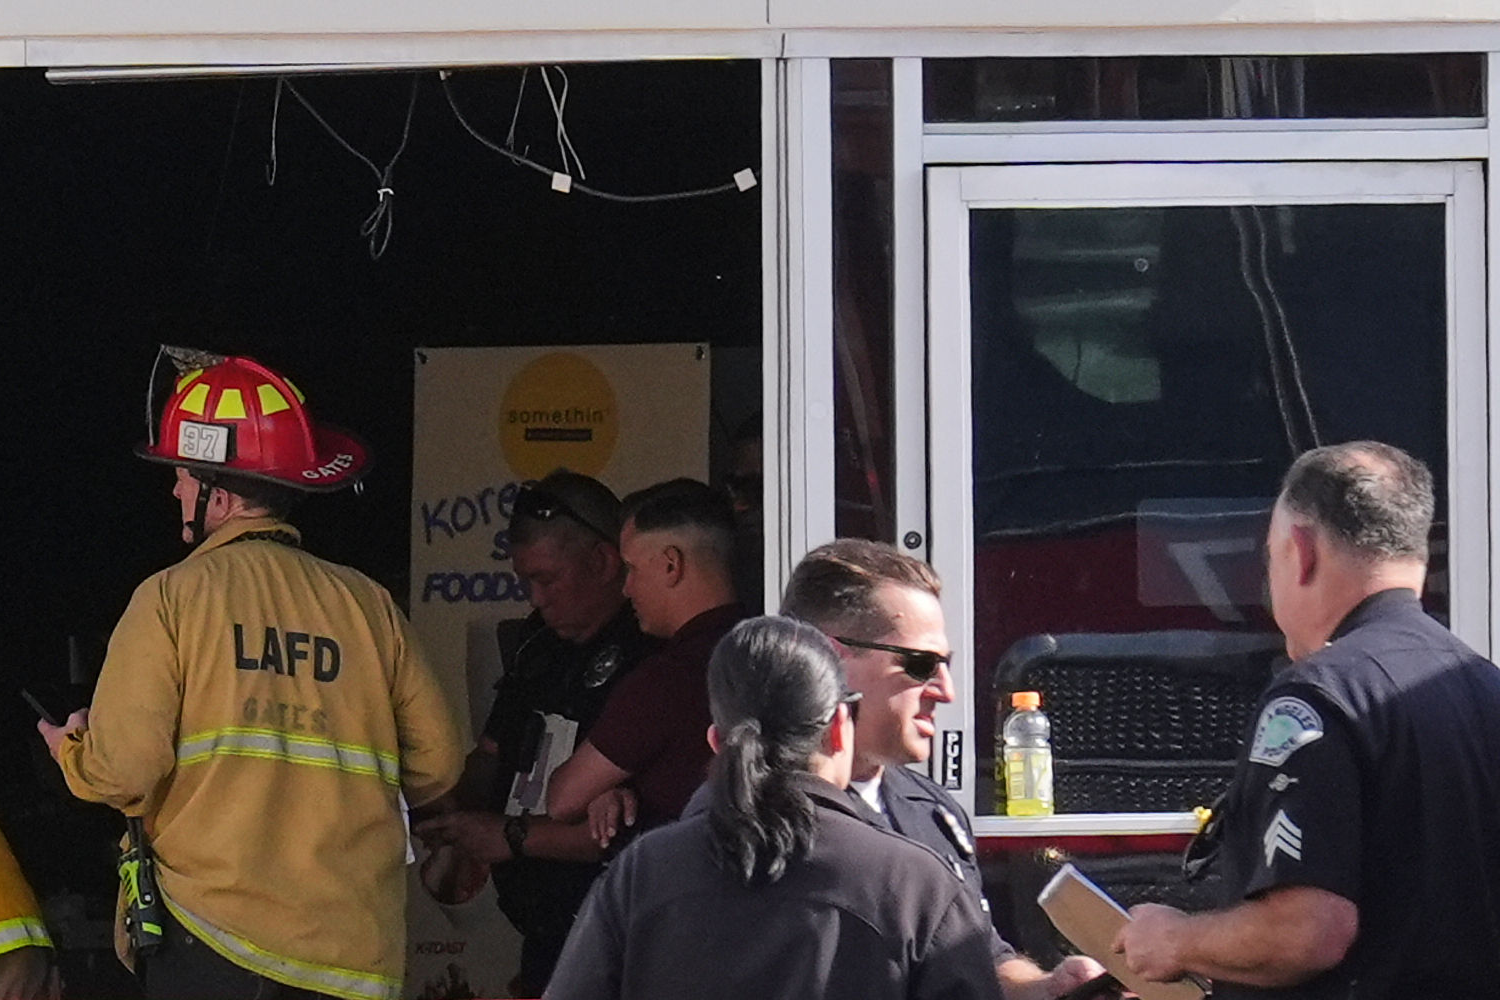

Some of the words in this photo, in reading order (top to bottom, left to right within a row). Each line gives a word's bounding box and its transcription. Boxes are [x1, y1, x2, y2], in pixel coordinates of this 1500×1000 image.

[182, 425, 220, 460] 37
[301, 452, 354, 480] GATES
[233, 623, 341, 683] LAFD
[946, 732, 960, 781] PULL
